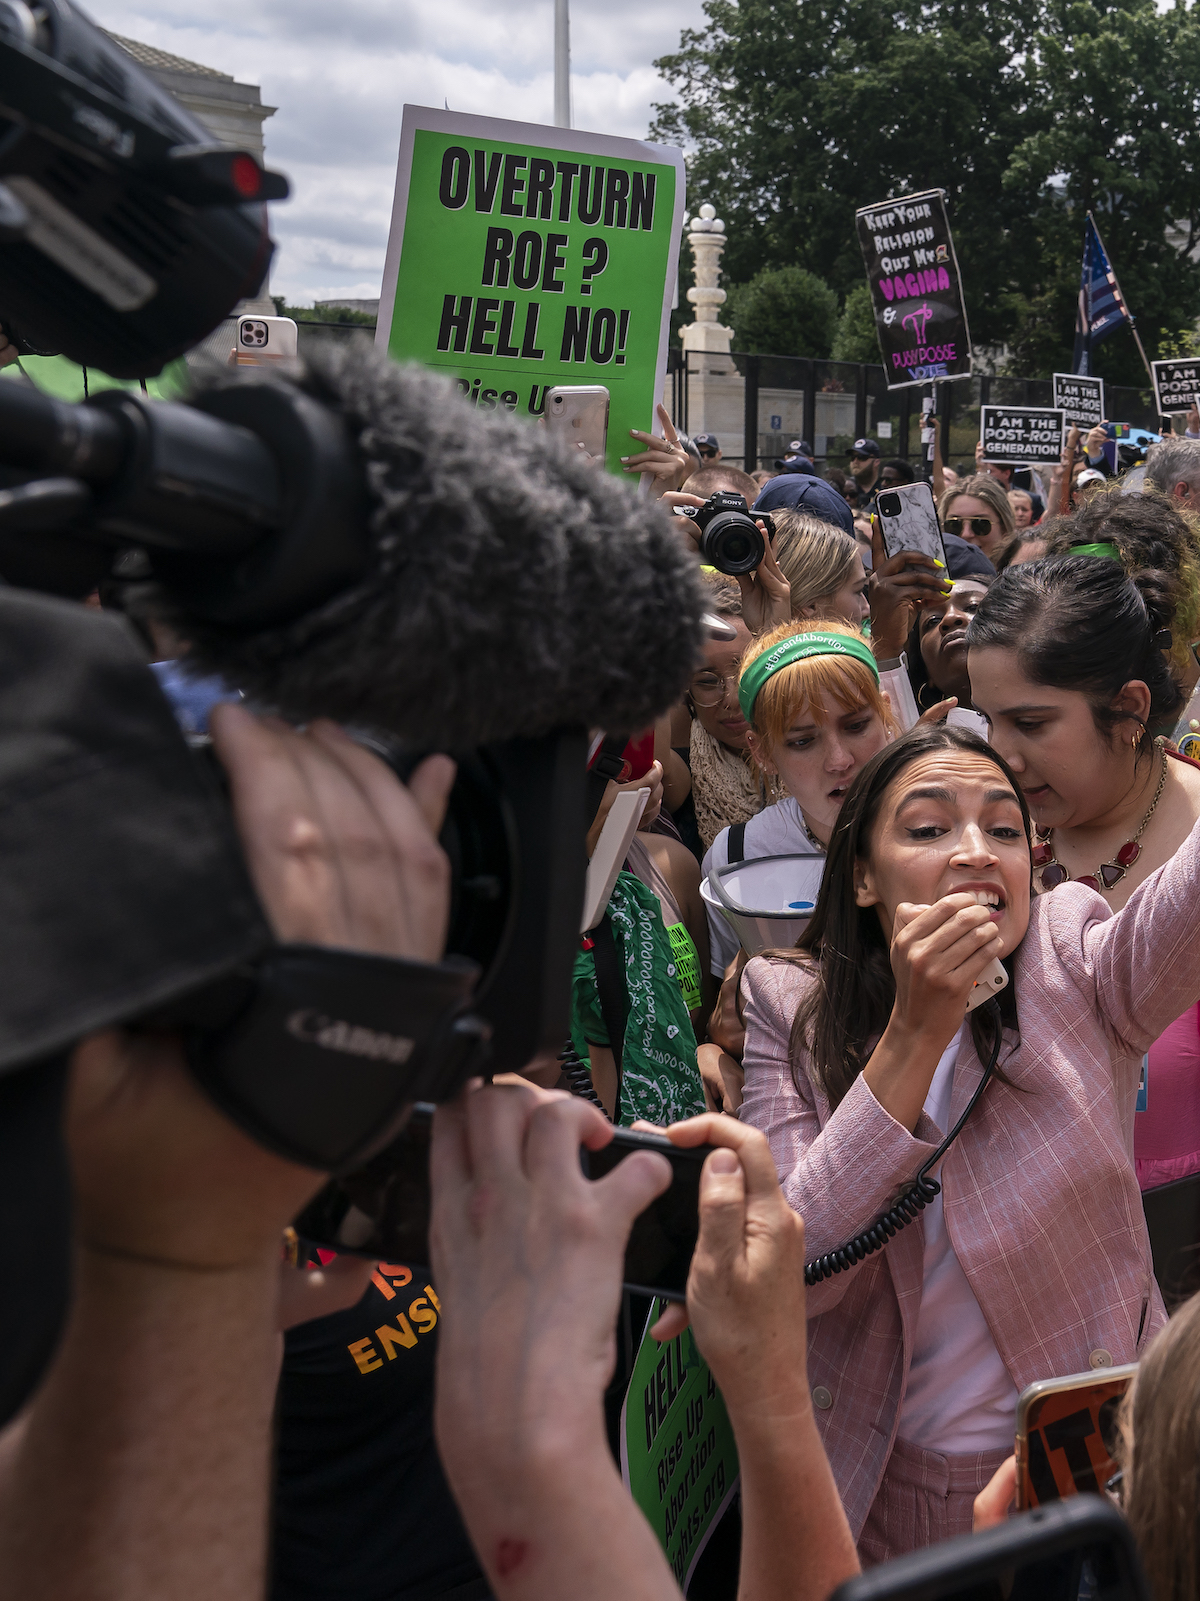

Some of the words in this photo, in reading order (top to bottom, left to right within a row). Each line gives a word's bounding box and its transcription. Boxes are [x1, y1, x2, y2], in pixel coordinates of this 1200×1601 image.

[439, 146, 657, 231] OVERTURN
[873, 226, 935, 254] RELIGION
[482, 226, 569, 293] ROE
[580, 237, 609, 295] ?
[880, 255, 911, 275] OUT
[913, 248, 936, 268] MY
[879, 266, 950, 301] VAGINA
[437, 294, 545, 360] HELL
[560, 304, 630, 365] NO!
[1064, 385, 1078, 396] AM
[1080, 387, 1098, 398] THE
[1172, 368, 1196, 380] AM
[985, 428, 1061, 443] POST-ROE
[1000, 417, 1023, 428] AM
[1028, 418, 1057, 429] THE
[985, 442, 1060, 455] GENERATION
[765, 633, 847, 671] #Green4Abortion
[657, 1431, 684, 1503] Rise
[686, 1394, 705, 1441] Up
[665, 1425, 717, 1550] Abortion
[671, 1459, 726, 1588] ights.org
